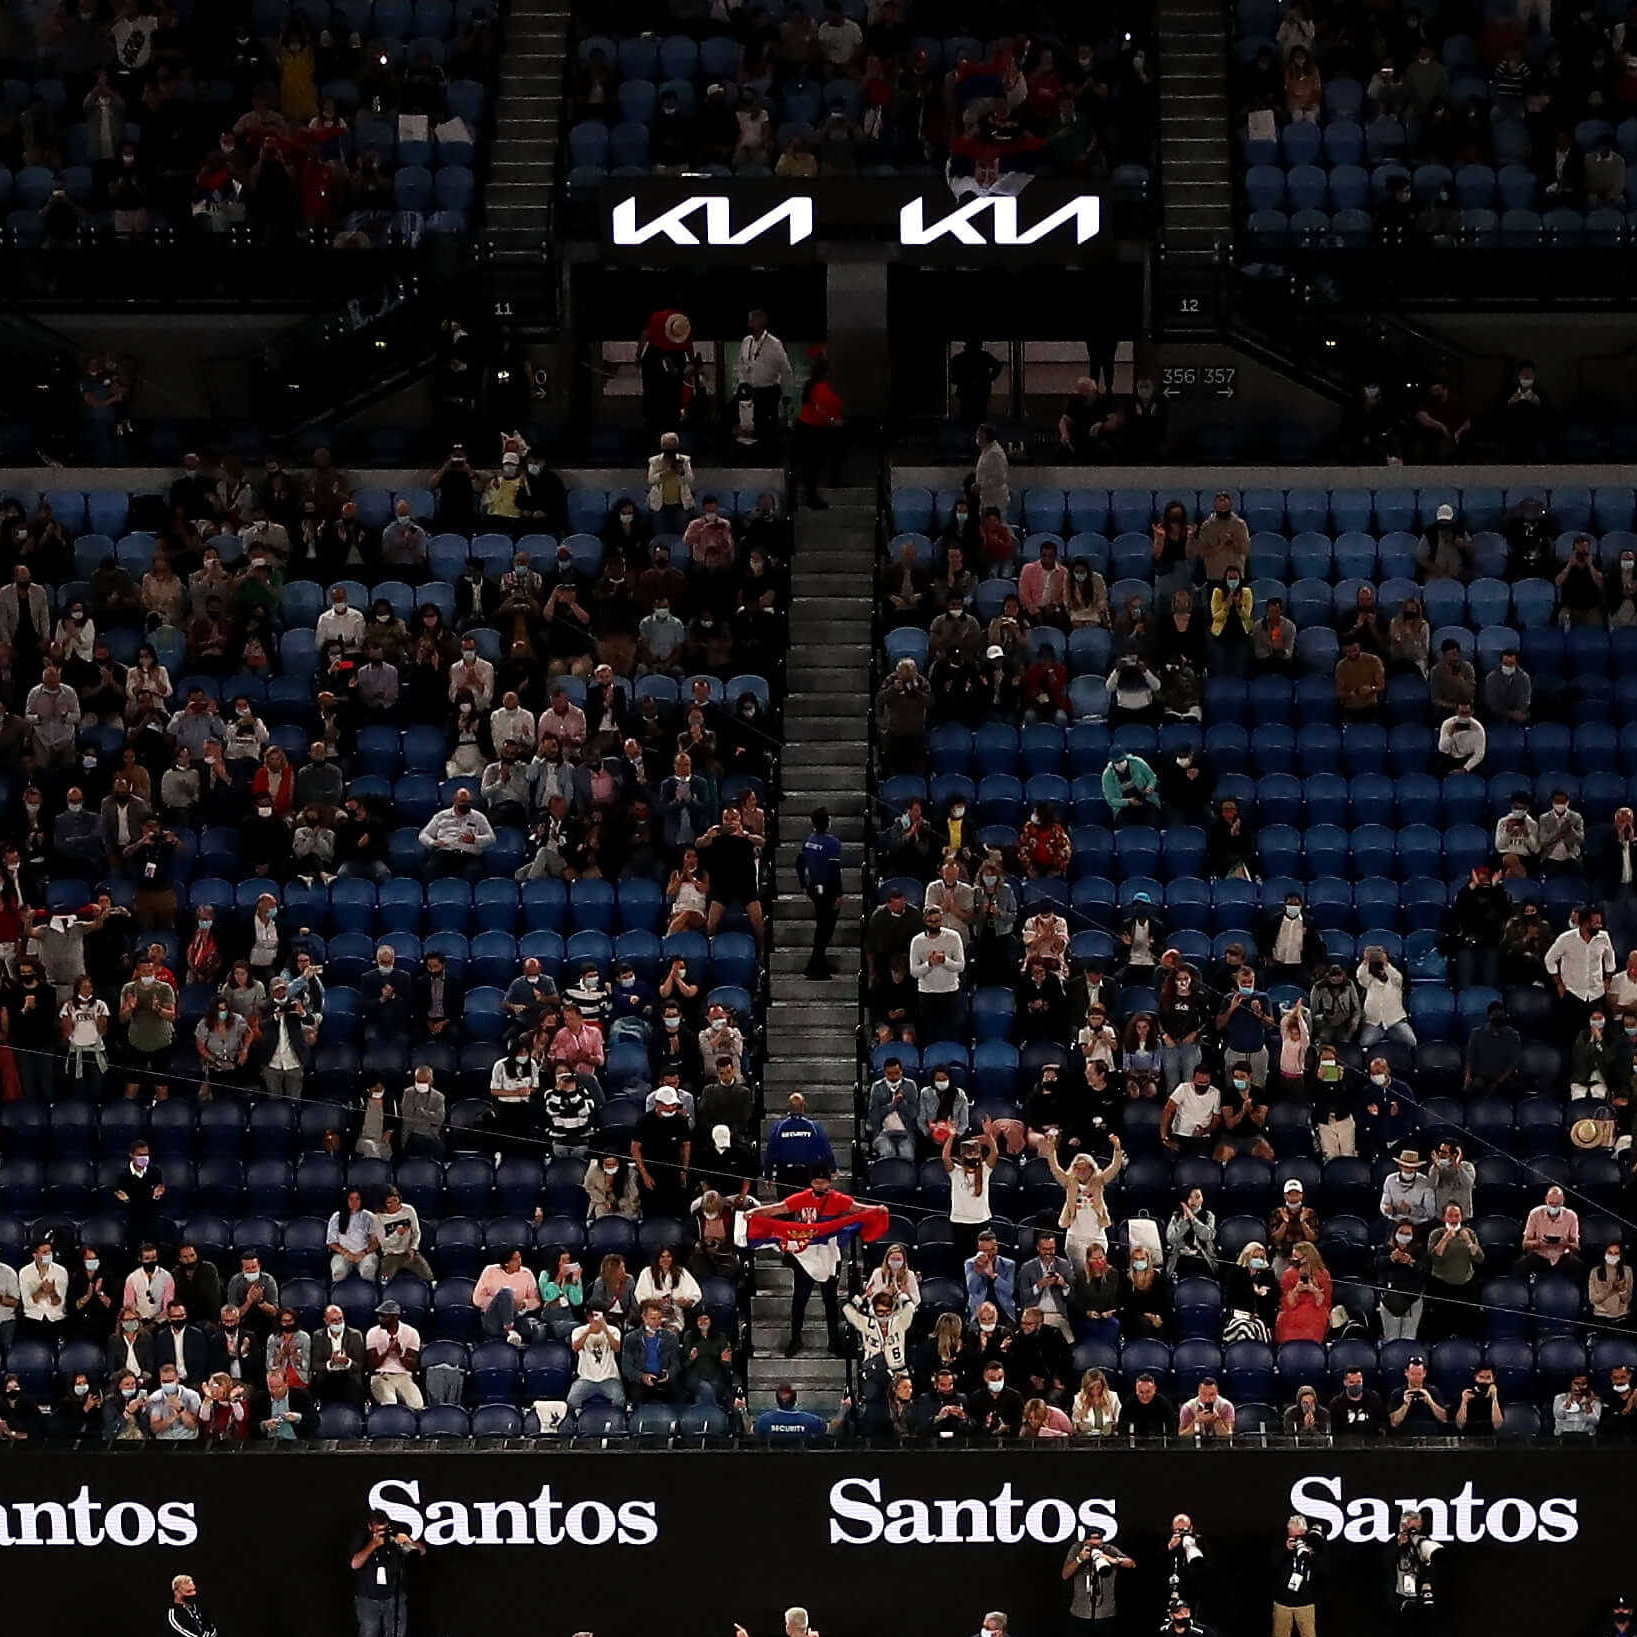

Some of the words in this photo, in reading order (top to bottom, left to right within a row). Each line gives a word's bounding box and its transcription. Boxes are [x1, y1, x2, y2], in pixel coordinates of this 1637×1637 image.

[612, 196, 813, 246] KIA
[900, 196, 1100, 245] KIA
[494, 302, 513, 315] 11
[1180, 299, 1200, 312] 12
[1162, 368, 1195, 384] 356
[1203, 368, 1235, 384] 357
[771, 1424, 805, 1433] SECURITY
[368, 1479, 659, 1546] Santos
[829, 1477, 1119, 1544] Santos
[1289, 1476, 1580, 1543] Santos
